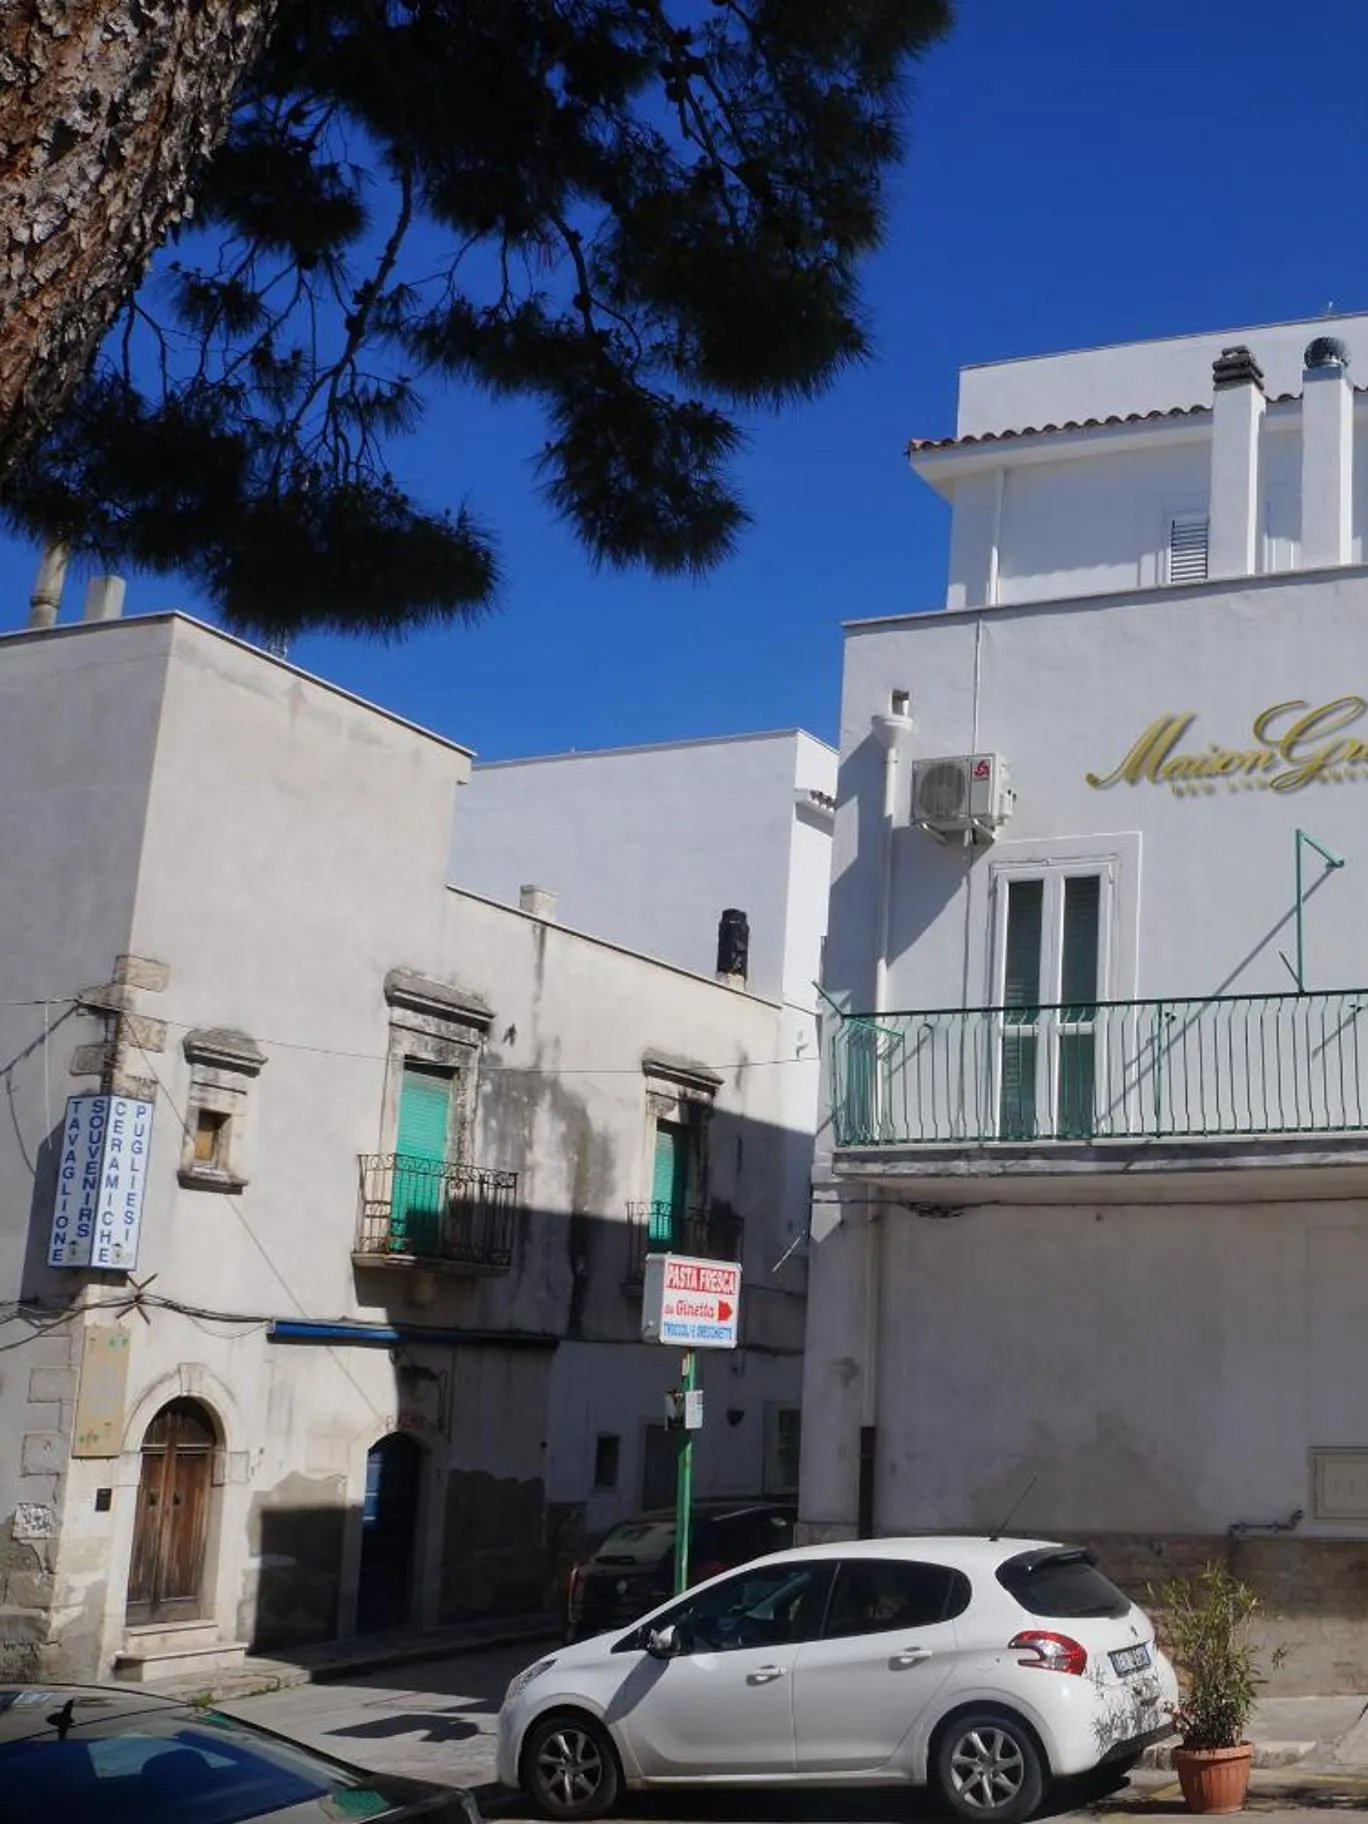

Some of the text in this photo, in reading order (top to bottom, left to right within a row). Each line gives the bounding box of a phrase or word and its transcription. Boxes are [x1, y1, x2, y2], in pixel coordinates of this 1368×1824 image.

[1085, 709, 1276, 789] Maison
[52, 1101, 83, 1262] TAVAGLIONE
[76, 1099, 105, 1238] SOUVENIRS
[99, 1101, 127, 1263] CERAMICHE
[123, 1105, 147, 1242] PUGLIESI
[667, 1265, 735, 1294] PASTA FRESCA
